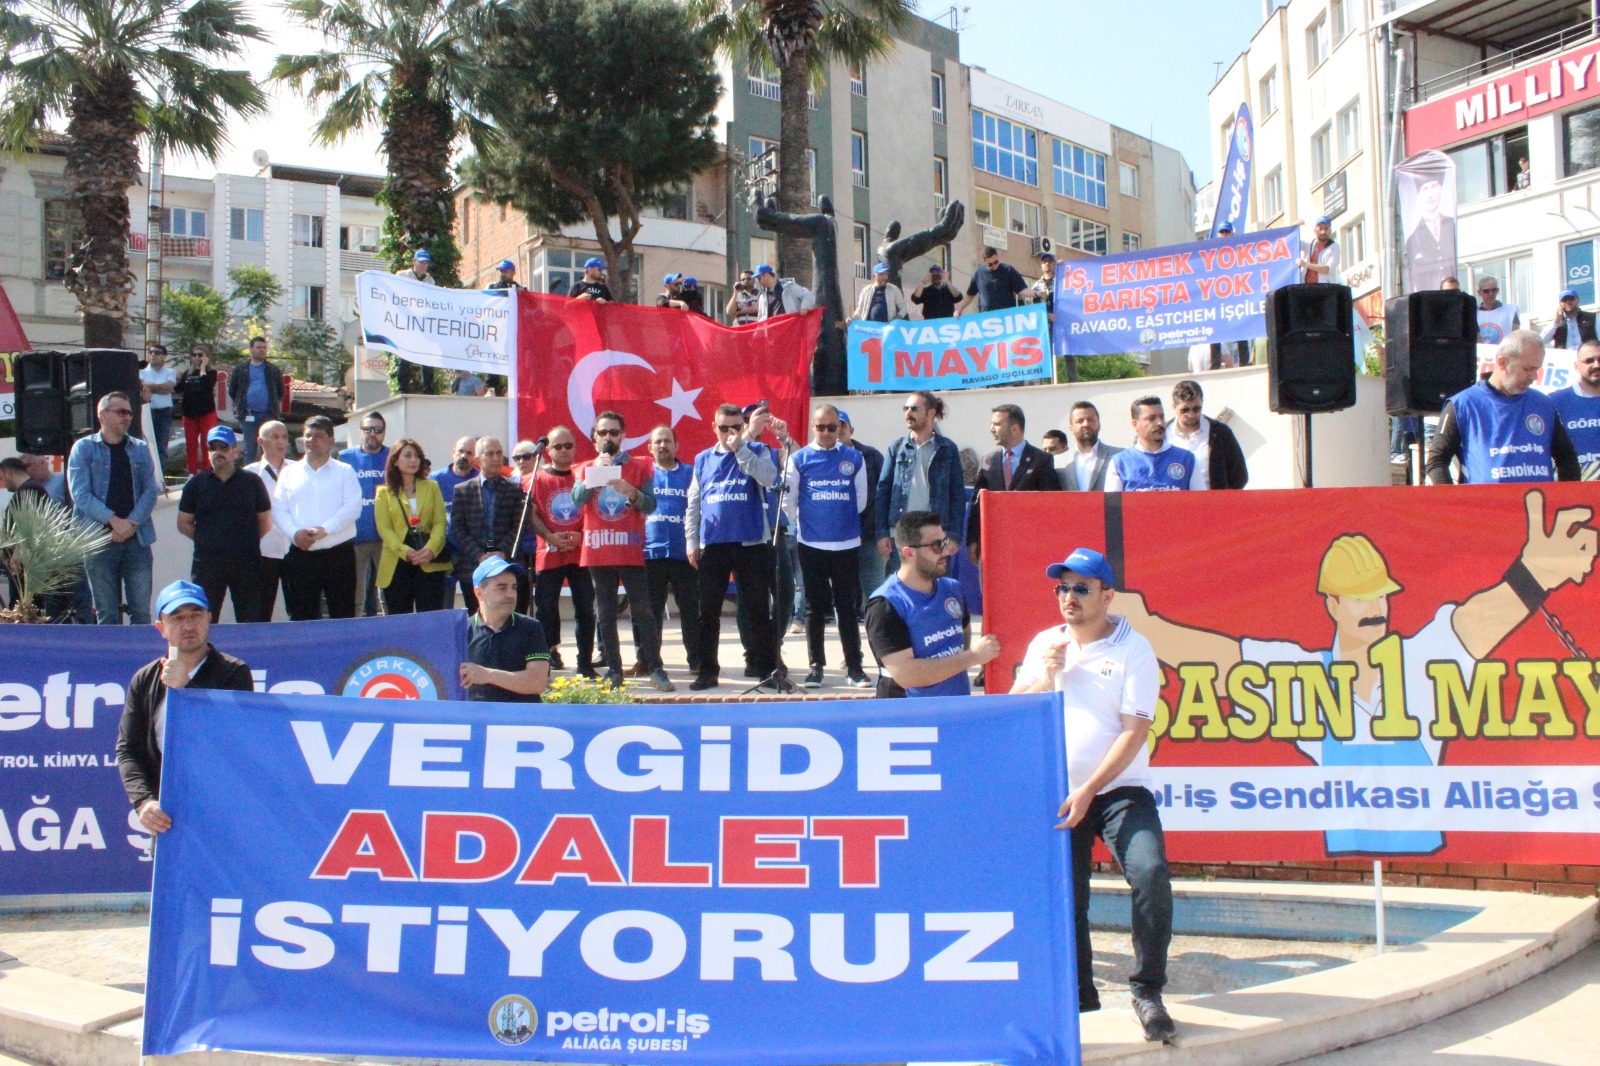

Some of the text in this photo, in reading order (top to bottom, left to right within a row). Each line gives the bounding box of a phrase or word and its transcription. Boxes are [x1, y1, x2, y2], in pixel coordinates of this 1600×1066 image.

[1004, 94, 1045, 119] TARKAN
[1455, 51, 1600, 130] MİLLİY
[1063, 237, 1292, 294] İŞ, EKMEK YOKSA
[371, 287, 510, 321] En bereketli yağmur
[1083, 281, 1191, 314] BARIŞTA
[1196, 272, 1254, 301] YOK
[900, 312, 1037, 347] YAŞASIN
[1071, 317, 1131, 334] RAVAGO,
[1136, 307, 1216, 329] EASTCHEM
[861, 336, 1043, 383] 1 MAYIS
[962, 373, 998, 384] RAVAGO
[1489, 443, 1544, 457] petrol-iş
[1491, 463, 1549, 479] SENDİKASI
[812, 491, 850, 501] SENDİKASI
[1369, 632, 1421, 740] 1
[44, 751, 98, 767] KİMYA
[1230, 780, 1430, 810] Sendikası
[1444, 780, 1579, 817] Aliağa
[309, 809, 910, 889] ADALET
[547, 1008, 710, 1038] petrol-iş
[562, 1034, 688, 1053] ALİAĞA ŞUBESİ
